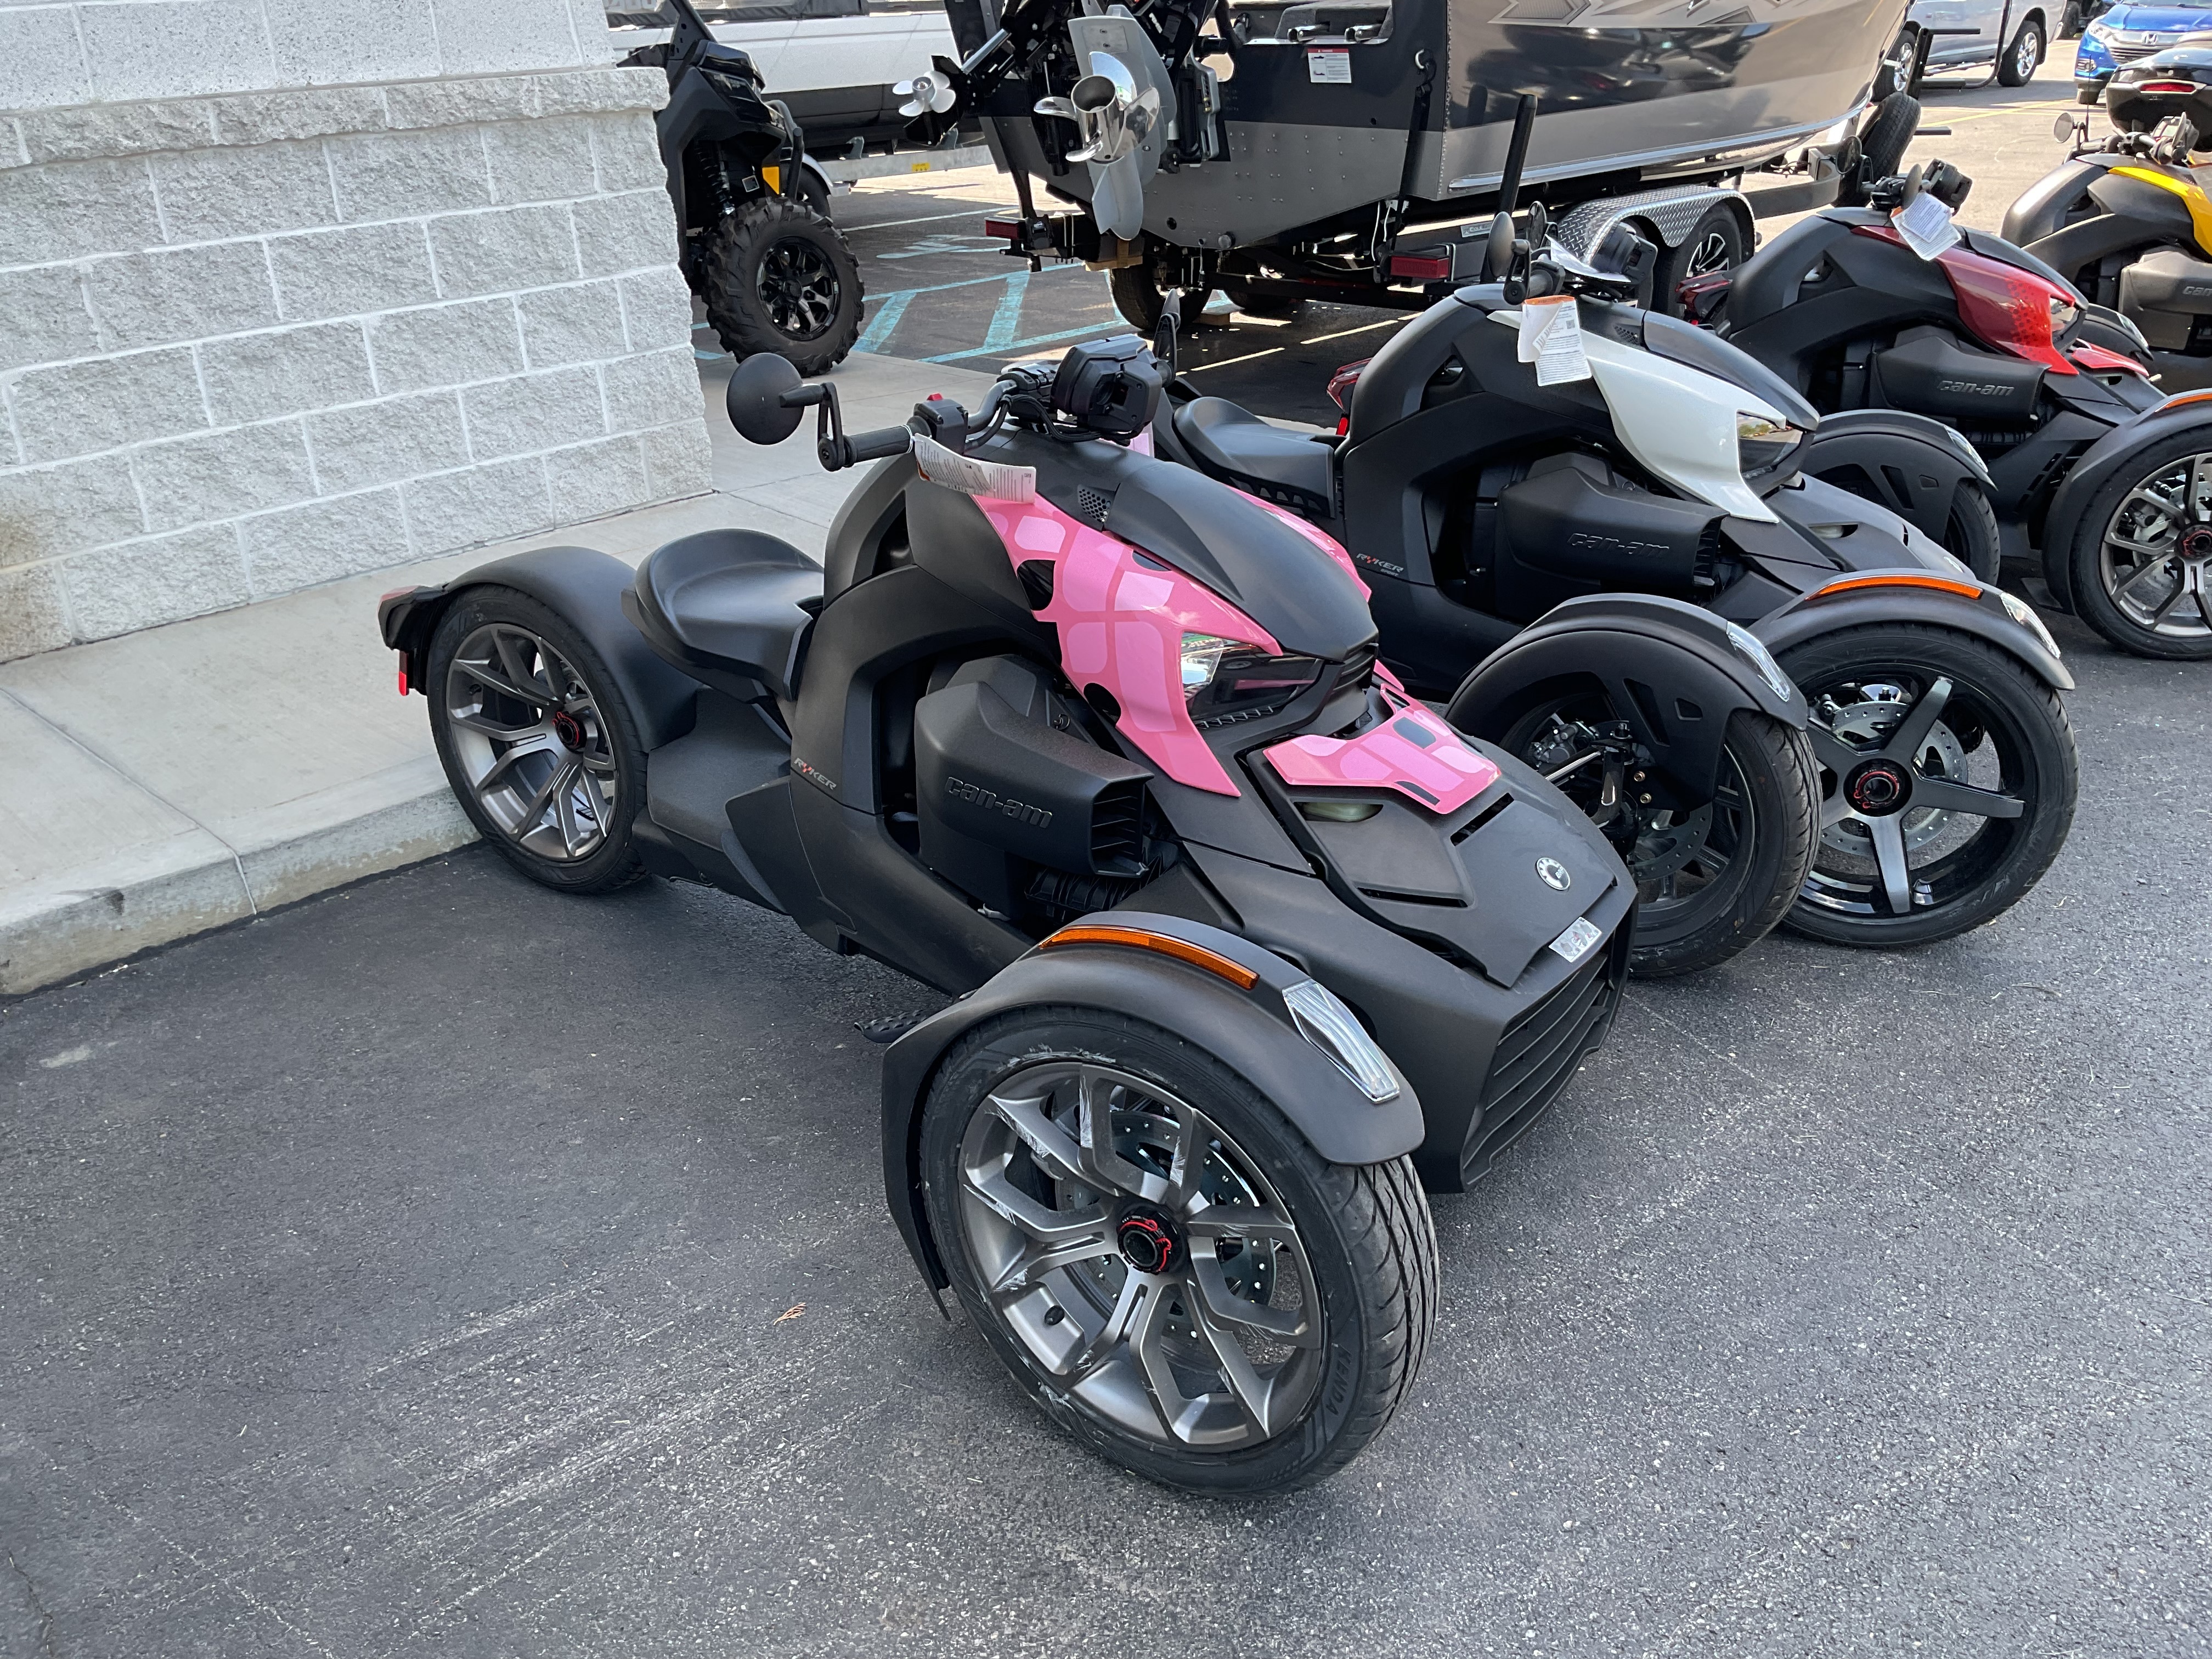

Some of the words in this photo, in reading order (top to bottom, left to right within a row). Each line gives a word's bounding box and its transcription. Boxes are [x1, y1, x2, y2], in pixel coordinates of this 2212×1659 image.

[1937, 380, 2015, 397] can-am
[1567, 533, 1669, 558] can-am
[1356, 553, 1404, 573] RYKER
[1380, 568, 1399, 577] SPORT
[794, 758, 837, 790] RYKER
[944, 776, 1053, 829] can-am
[1555, 866, 1564, 878] BRP
[1326, 1344, 1352, 1416] KENDA
